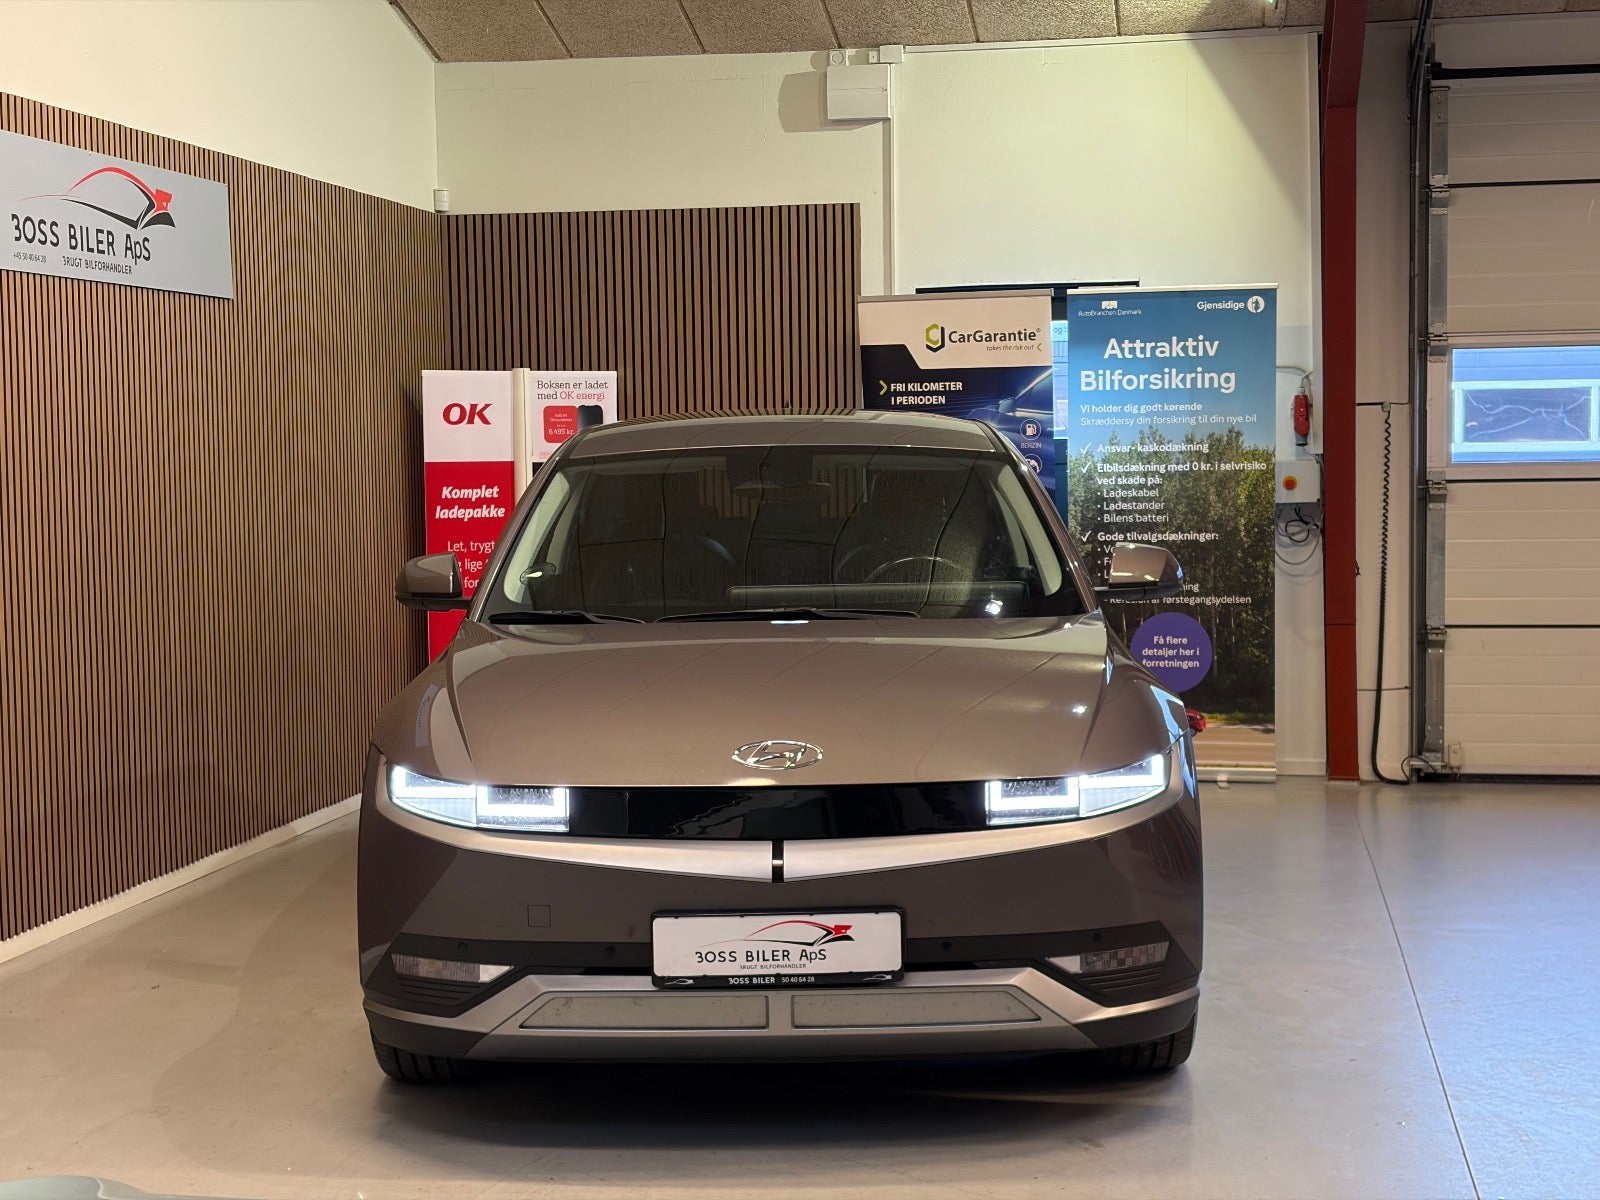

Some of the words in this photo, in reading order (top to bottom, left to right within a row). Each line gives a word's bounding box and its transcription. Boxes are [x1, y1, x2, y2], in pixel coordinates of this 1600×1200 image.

[11, 214, 60, 248] BOSS
[68, 224, 116, 257] BILER
[124, 234, 151, 265] ApS
[62, 256, 82, 268] BRUGT
[85, 259, 132, 275] BILFORHANDLER
[1197, 300, 1245, 311] Gjensidige
[1104, 335, 1220, 359] Attraktiv
[537, 380, 570, 389] Boksen
[584, 380, 608, 389] ladet
[1080, 367, 1236, 394] Bilforsikring
[890, 383, 905, 392] FRI
[908, 382, 963, 392] KILOMETER
[537, 391, 558, 400] med
[560, 391, 574, 400] OK
[576, 391, 605, 402] energi
[896, 396, 946, 405] PERIODEN
[442, 403, 493, 425] OK
[1080, 404, 1090, 413] Vi
[1092, 404, 1122, 413] holder
[1124, 403, 1139, 414] dig
[1141, 403, 1162, 414] godt
[1164, 402, 1202, 412] kørende
[1080, 416, 1136, 426] Skræddersy
[1138, 416, 1151, 425] din
[1153, 415, 1196, 425] forsikring
[1198, 415, 1208, 423] til
[1210, 415, 1224, 423] din
[1226, 416, 1243, 425] nye
[1245, 414, 1257, 423] bil
[1097, 444, 1135, 453] Ansvar-
[1137, 443, 1209, 454] kaskodækning
[1098, 463, 1166, 474] Elbilsdækning
[1168, 462, 1190, 472] med
[1192, 462, 1199, 471] 0
[1201, 462, 1213, 471] kr.
[1220, 462, 1267, 471] selvrisiko
[1097, 476, 1115, 485] ved
[1117, 475, 1145, 485] skade
[1148, 474, 1163, 486] på:
[442, 485, 499, 502] Komplet
[1103, 489, 1159, 498] Ladeskabel
[1103, 501, 1165, 510] Ladestander
[435, 506, 506, 521] ladepakke
[1103, 514, 1134, 523] Bilens
[1136, 513, 1169, 523] batteri
[1097, 532, 1124, 541] Gode
[1126, 531, 1219, 542] tilvalgsdækninger:
[447, 541, 466, 552] Let,
[470, 541, 495, 553] trygt
[465, 559, 483, 571] lige
[1153, 636, 1164, 645] Få
[1166, 636, 1187, 645] flere
[1142, 647, 1177, 657] detaljer
[1179, 647, 1195, 656] her
[1142, 659, 1199, 668] forretningen
[695, 951, 737, 963] BOSS
[745, 950, 790, 962] BILER
[799, 949, 827, 963] ApS
